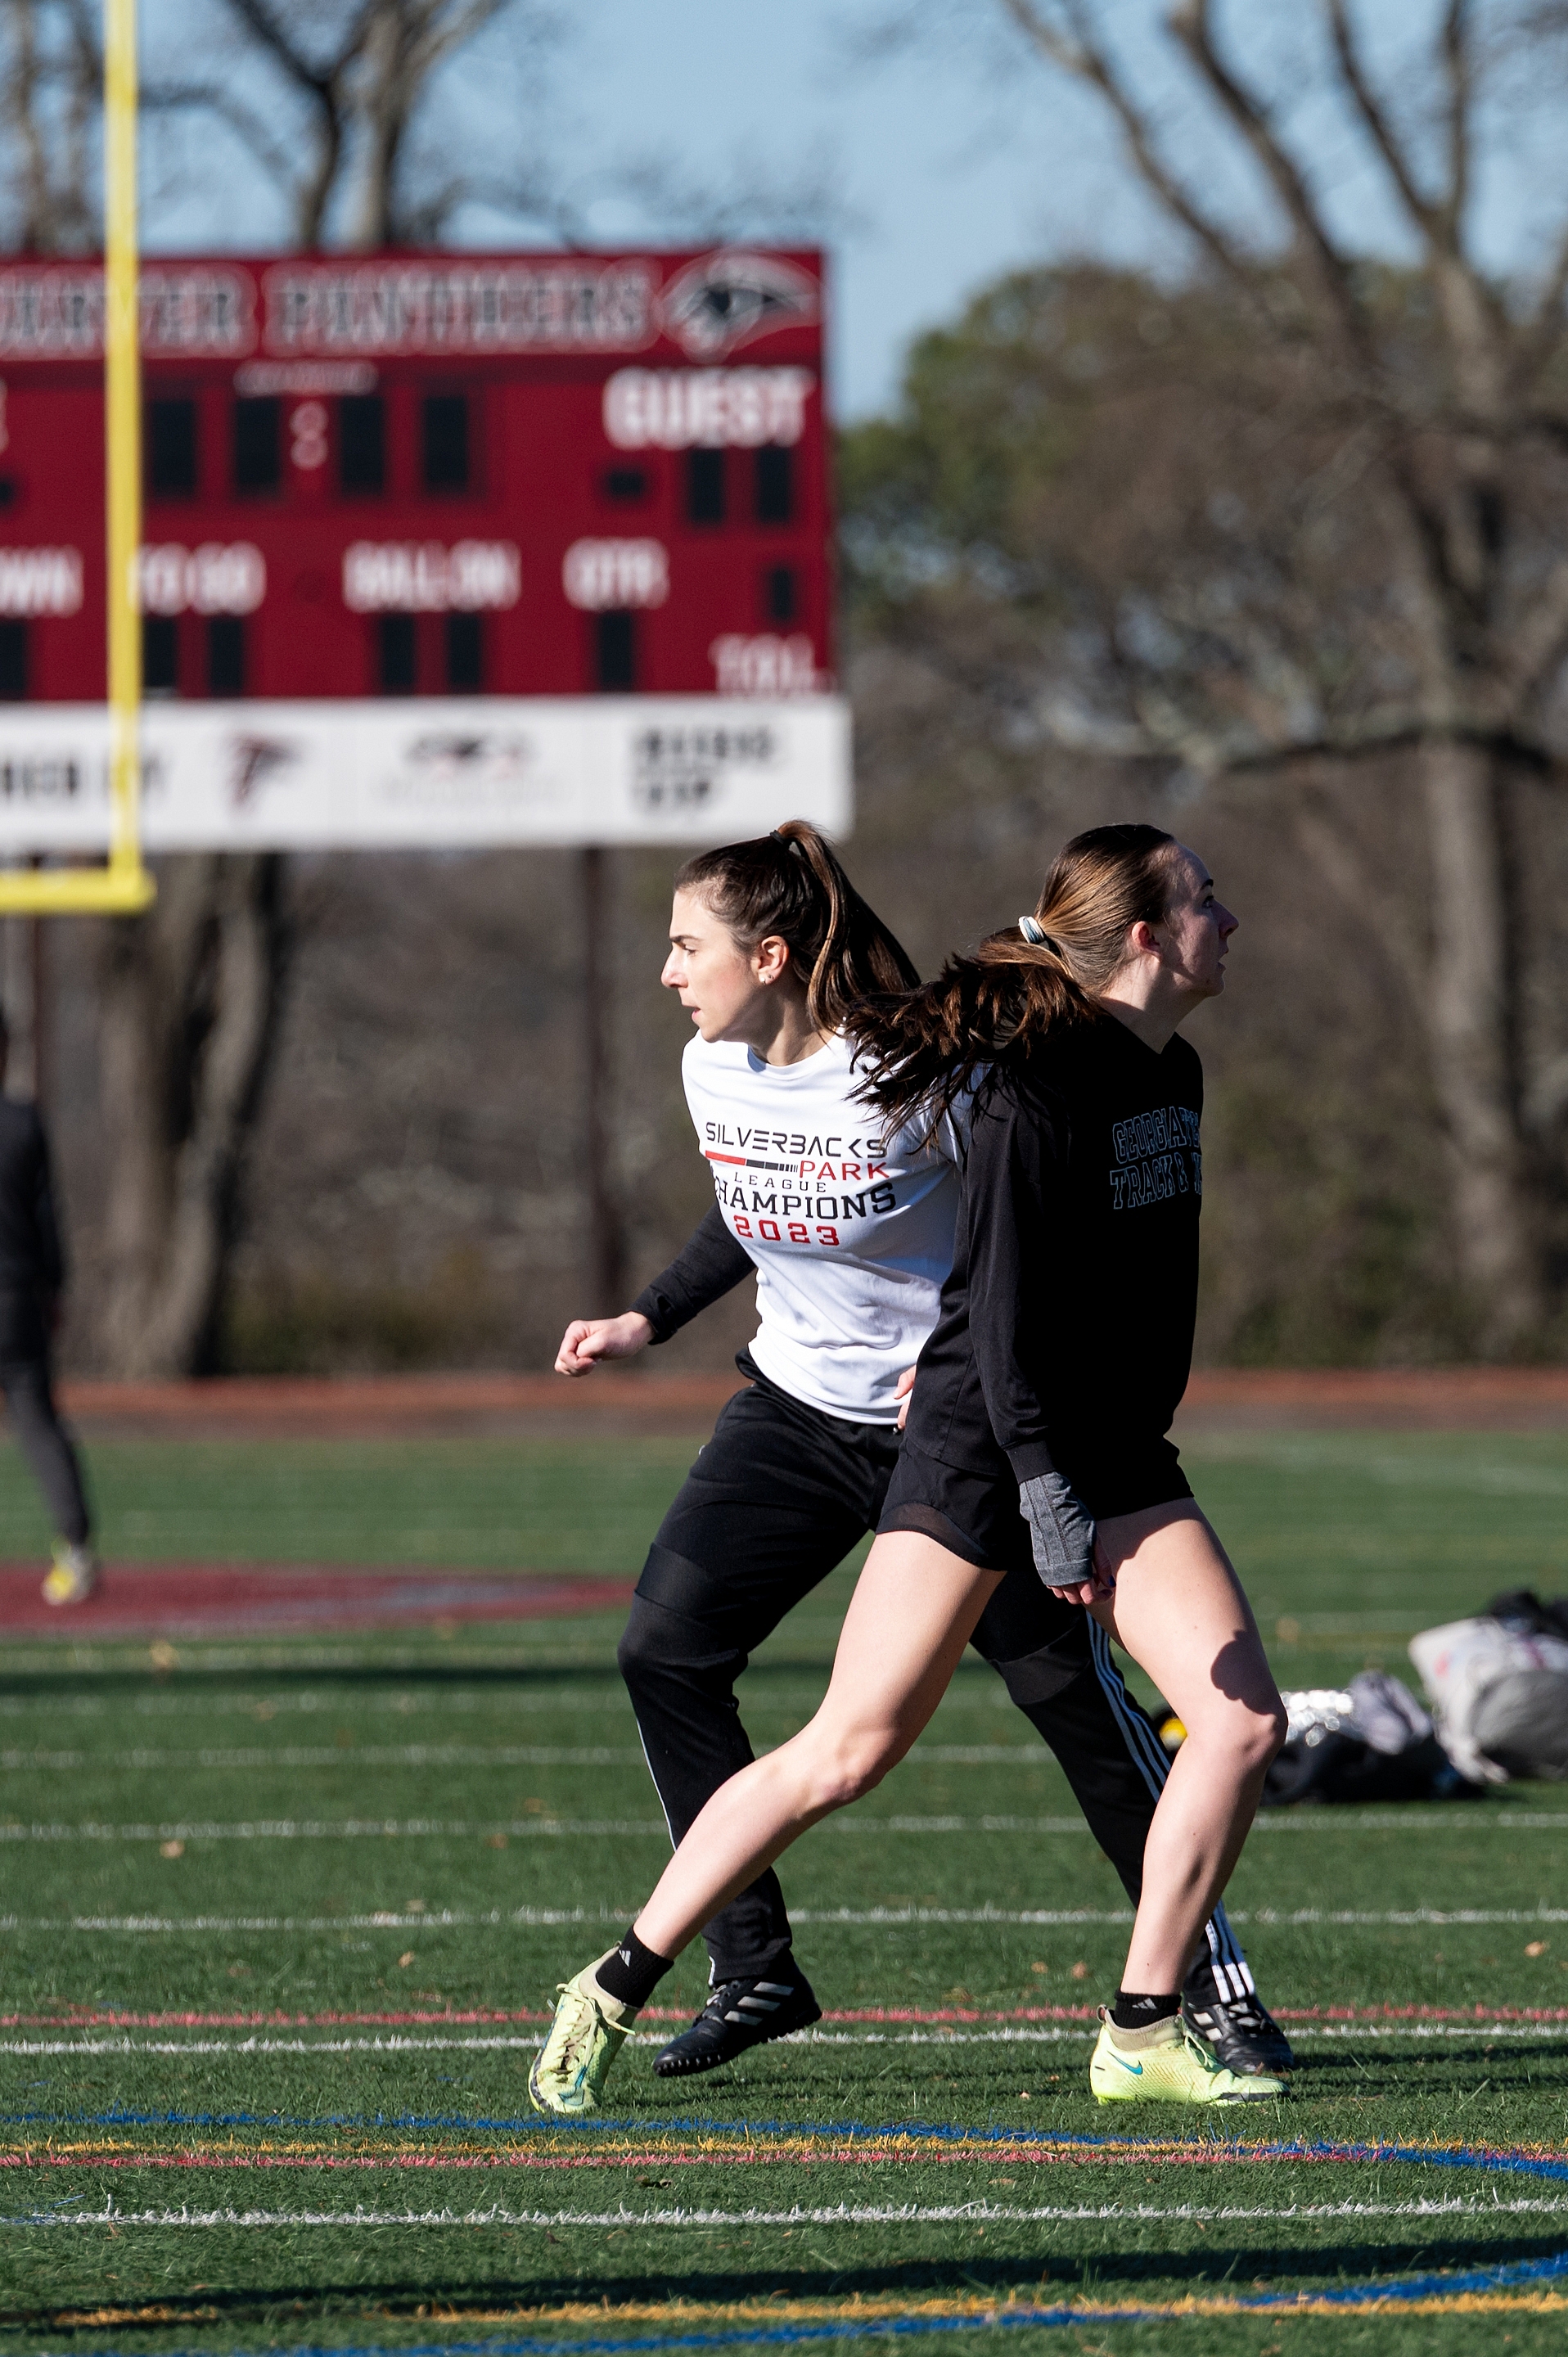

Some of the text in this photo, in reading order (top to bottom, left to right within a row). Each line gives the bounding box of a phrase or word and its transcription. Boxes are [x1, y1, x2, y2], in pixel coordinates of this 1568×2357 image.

[265, 264, 656, 357] PANTHERS
[605, 367, 813, 448] GUEST
[705, 1121, 889, 1159] SILVERBACKS
[1112, 1106, 1187, 1164] GEORGIA
[733, 1172, 827, 1192] LEAGUE
[799, 1160, 890, 1181] PARK
[1110, 1154, 1176, 1210] TRACK
[1174, 1151, 1189, 1192] &
[733, 1215, 840, 1246] 2023
